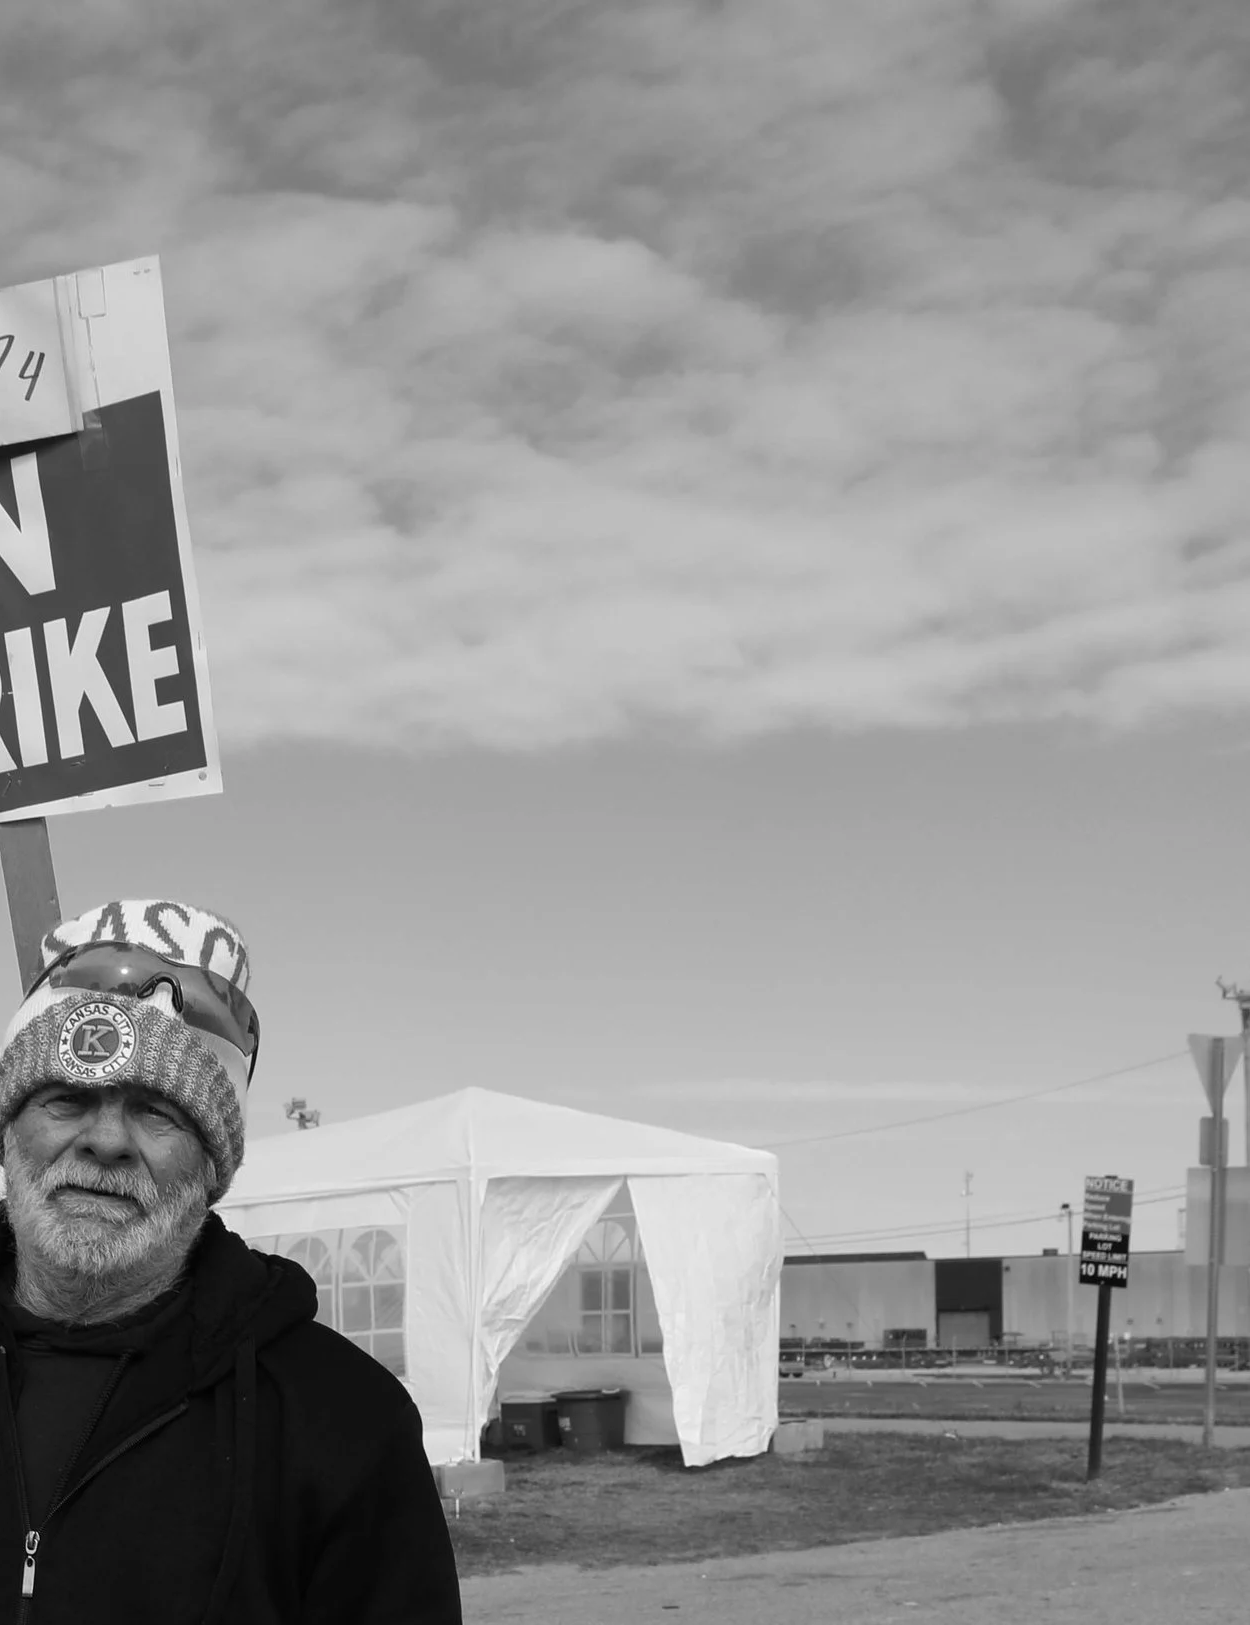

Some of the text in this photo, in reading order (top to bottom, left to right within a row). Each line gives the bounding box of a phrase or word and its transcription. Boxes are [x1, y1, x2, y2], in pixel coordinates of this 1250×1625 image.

[62, 1004, 134, 1038] KANSAS CITY
[77, 1024, 114, 1057] K
[60, 1049, 129, 1078] KANSAS CITY
[1085, 1179, 1128, 1192] NOTICE
[1088, 1232, 1122, 1242] PARKING
[1096, 1242, 1113, 1251] LOT
[1082, 1250, 1107, 1261] SPEED
[1081, 1262, 1128, 1279] 10 MPH
